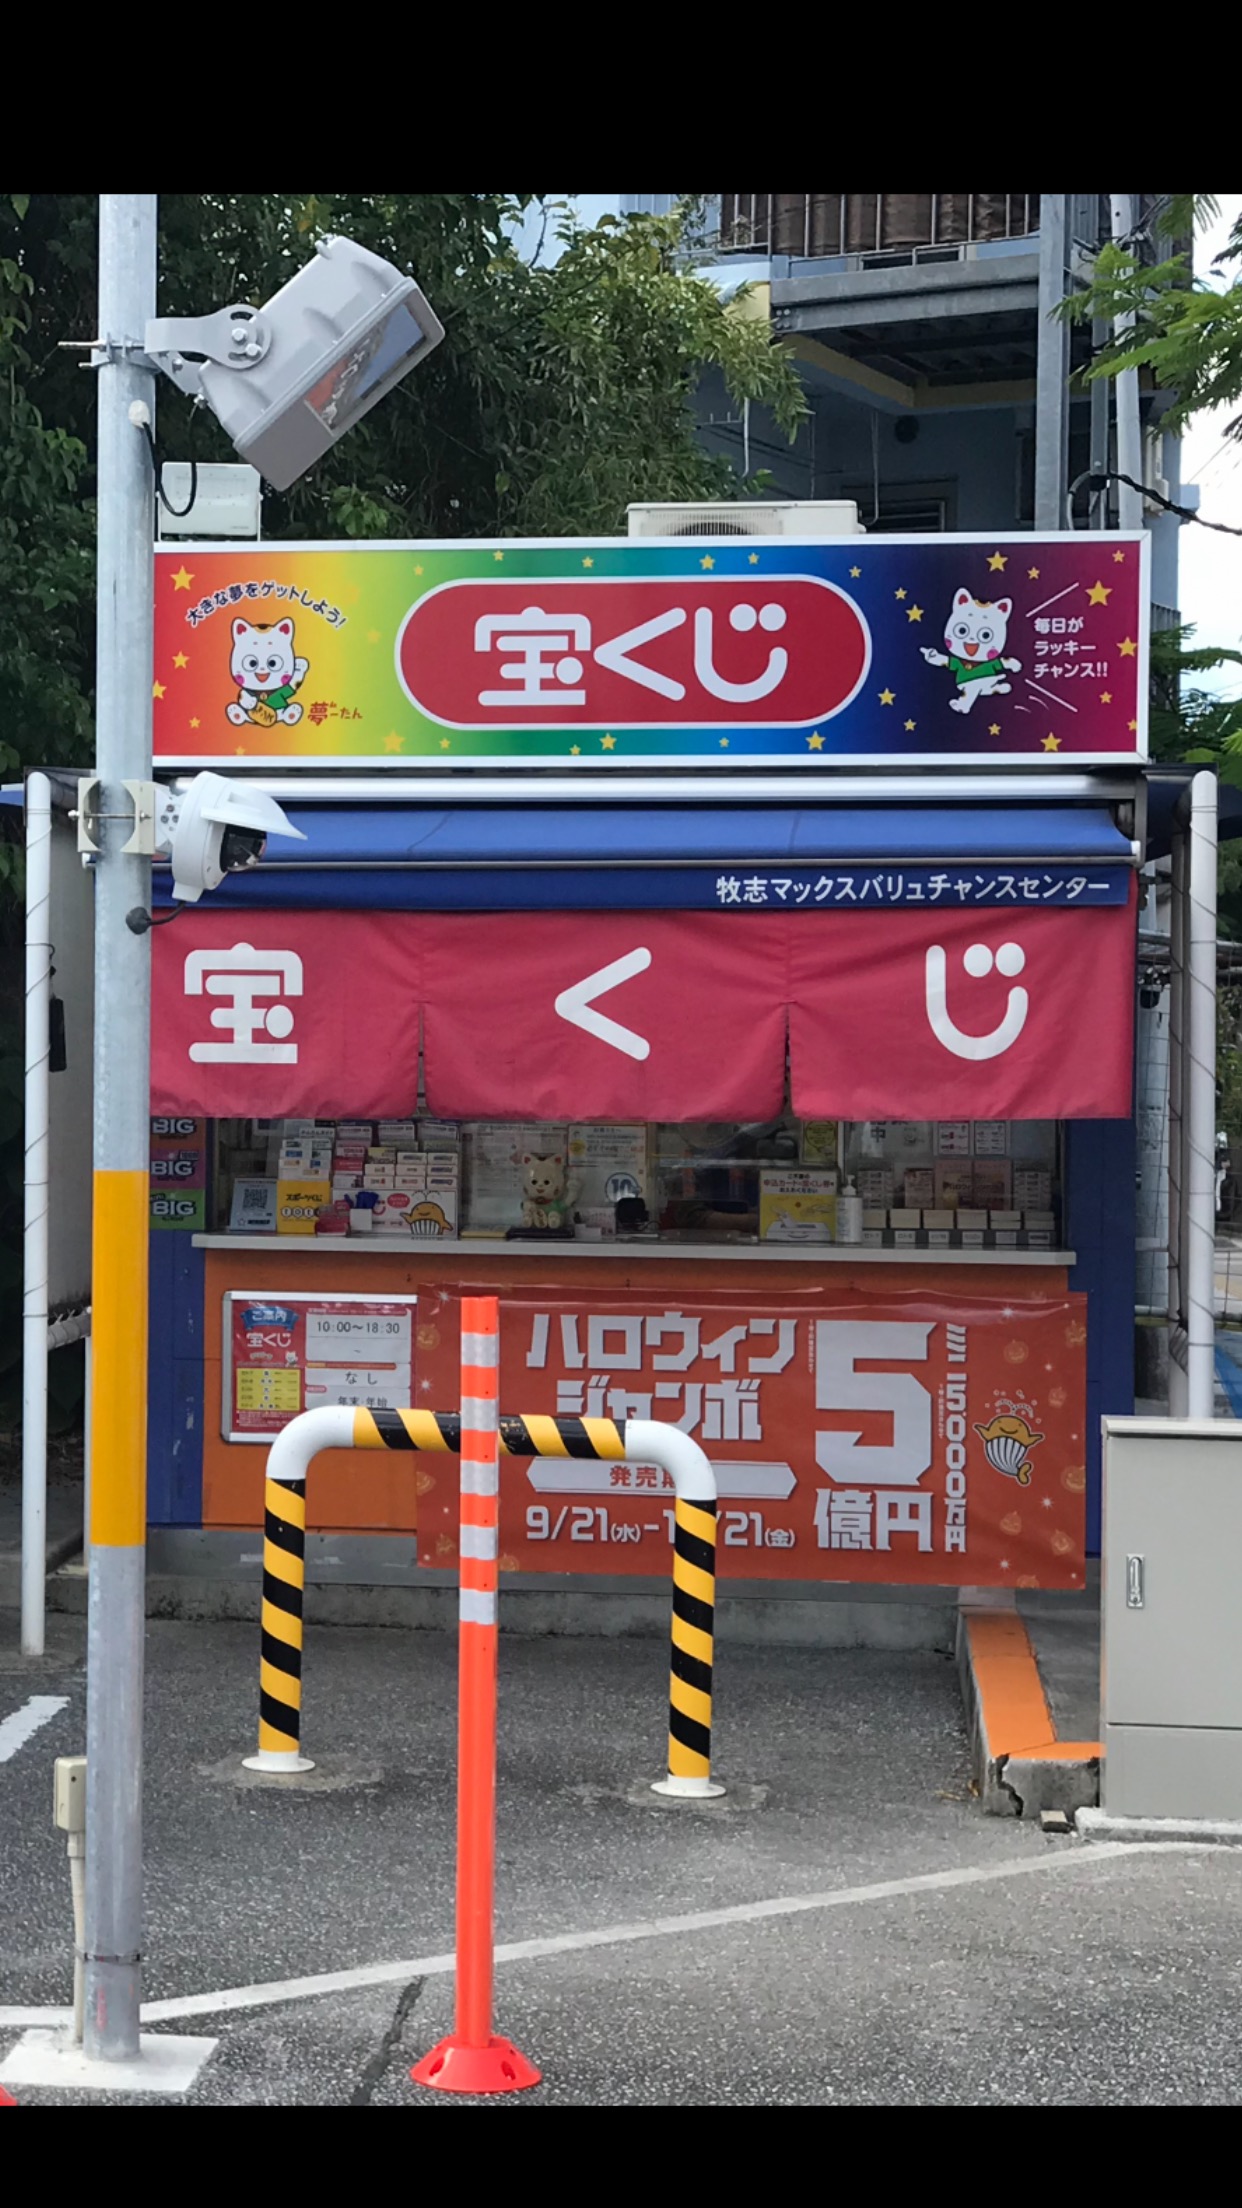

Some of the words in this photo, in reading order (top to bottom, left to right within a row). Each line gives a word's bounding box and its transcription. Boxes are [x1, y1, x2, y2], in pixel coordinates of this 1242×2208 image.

[186, 581, 346, 627] 大きな夢をゲットしよう!
[1034, 617, 1084, 634] 毎日が
[475, 604, 788, 706] 宝くじ
[1034, 640, 1096, 656] ラッキー
[1034, 661, 1108, 678] チャンス!!
[716, 874, 1110, 904] 牧志マックスバリュチャンスセンター
[152, 1119, 194, 1134] BIG
[151, 1160, 193, 1176] BIG
[152, 1200, 194, 1215] BIG
[246, 1332, 292, 1348] 宝くじ
[526, 1311, 797, 1373] ハロウィン
[557, 1375, 760, 1440] ジャンボ
